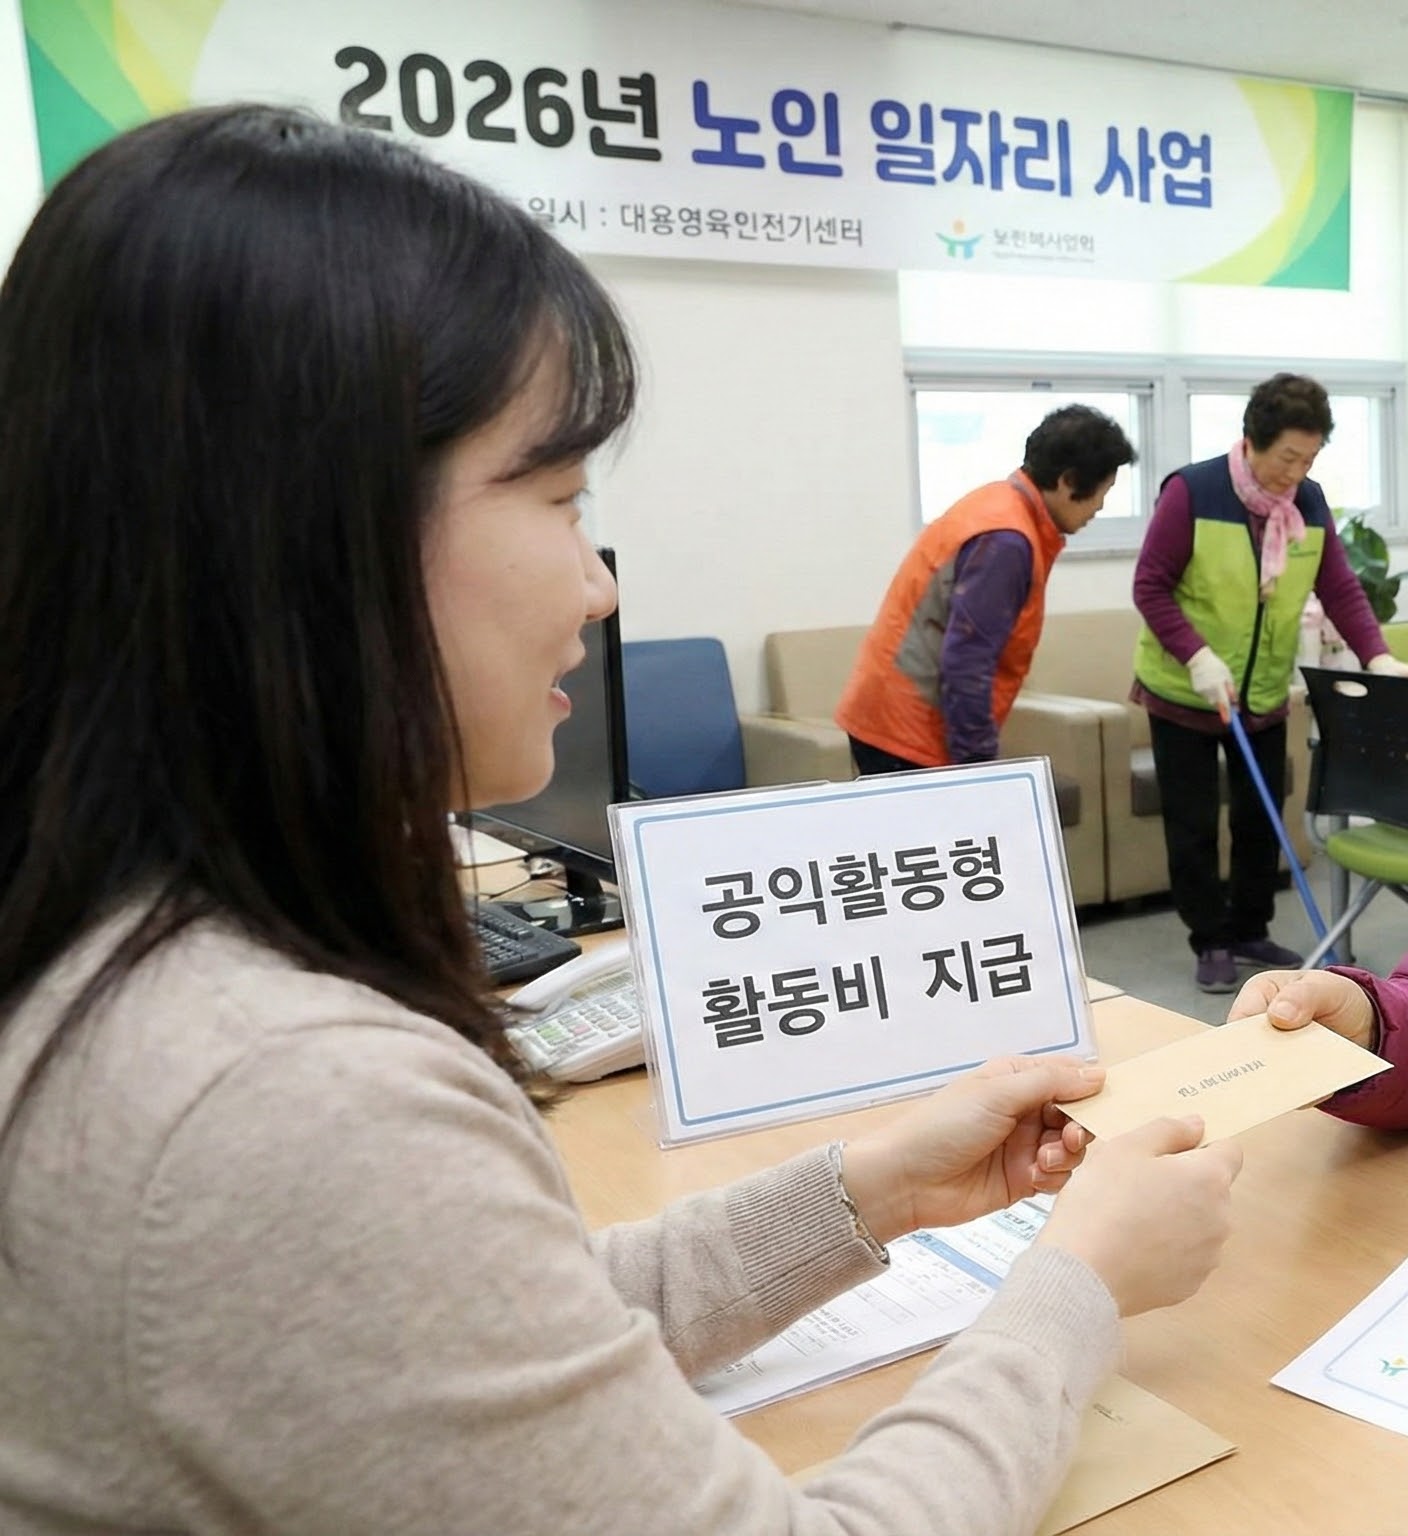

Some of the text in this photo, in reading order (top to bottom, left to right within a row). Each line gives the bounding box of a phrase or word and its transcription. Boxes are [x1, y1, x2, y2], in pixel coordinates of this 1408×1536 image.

[335, 46, 1213, 209] 2026년 노인 일자리 사업
[701, 836, 1005, 939] 공익활동형
[702, 933, 1034, 1049] 활동비 지급
